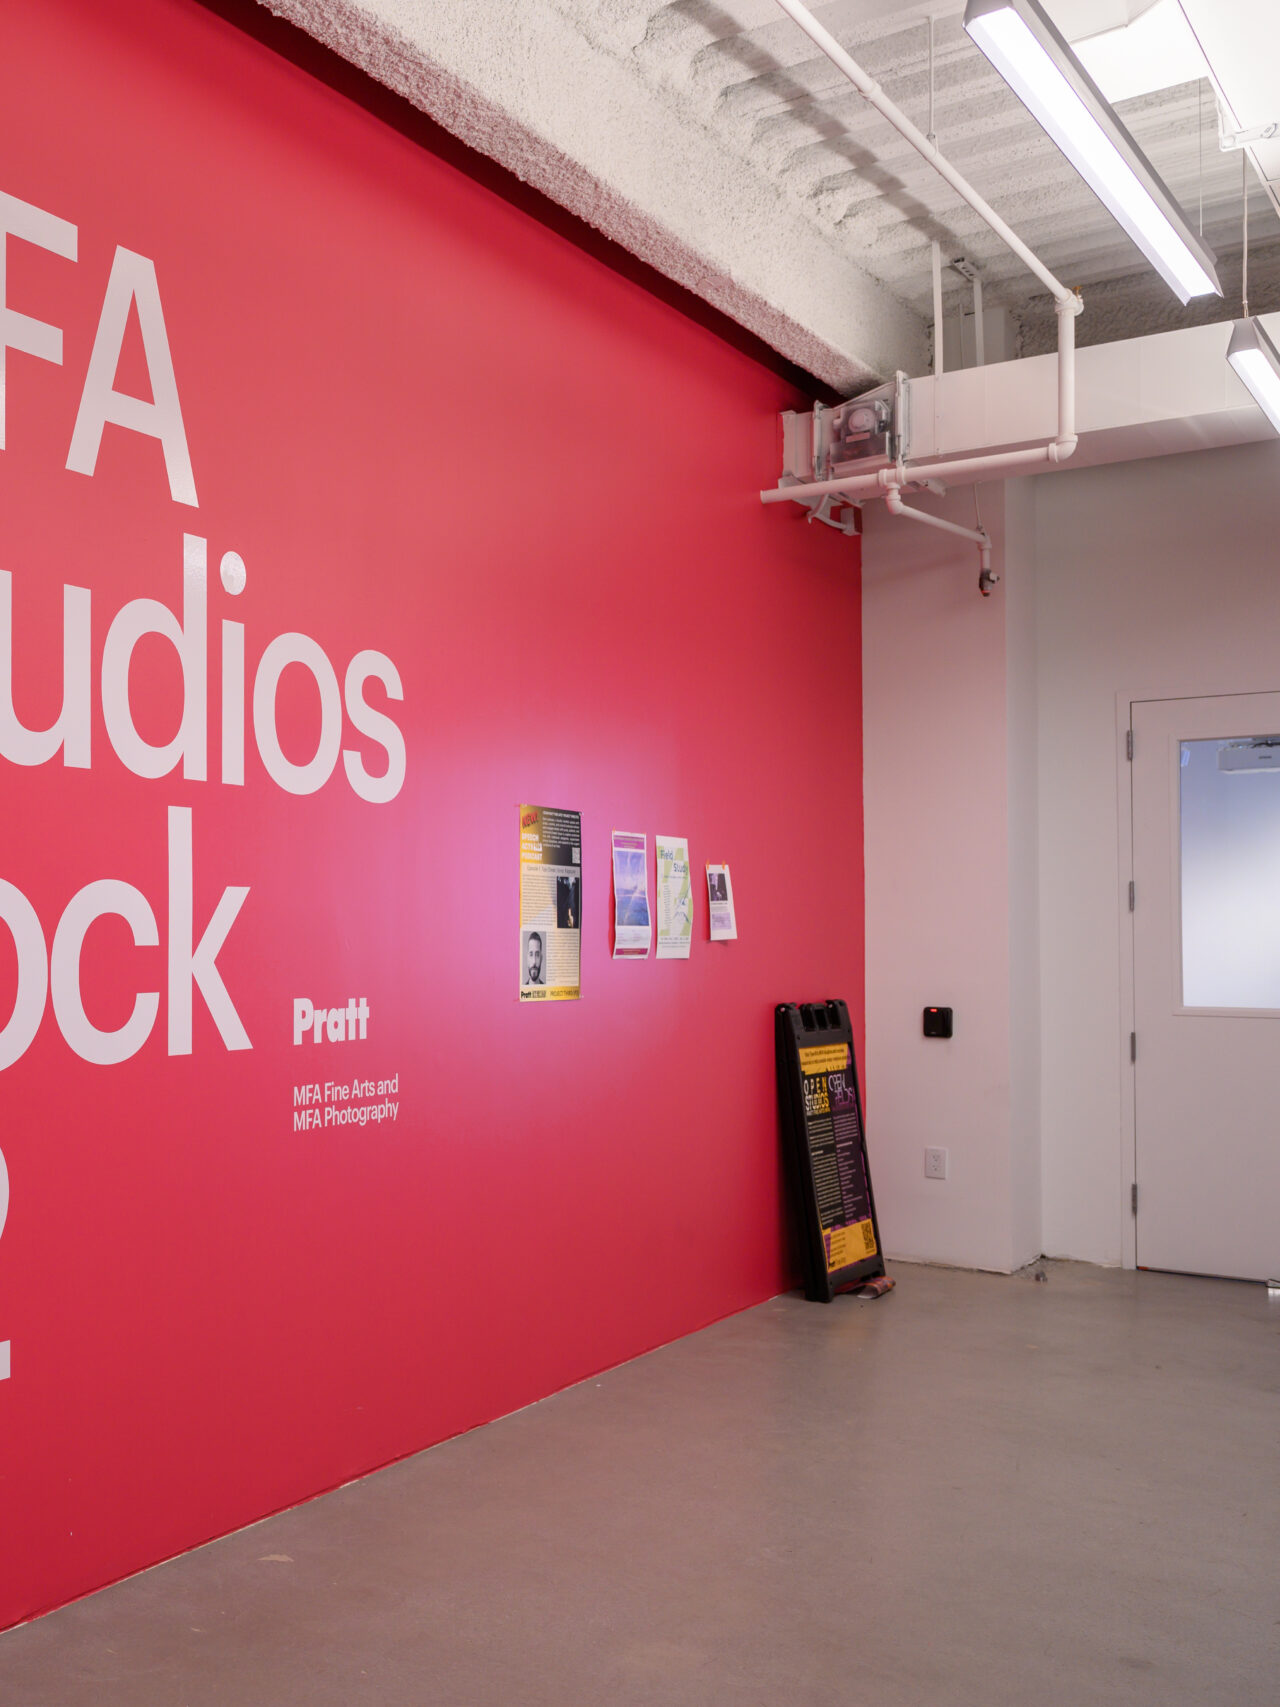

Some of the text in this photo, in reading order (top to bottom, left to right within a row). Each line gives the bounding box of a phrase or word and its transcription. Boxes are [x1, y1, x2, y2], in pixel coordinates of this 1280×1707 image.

[293, 998, 370, 1046] Pratt
[293, 1073, 399, 1107] MFA Fine Arts and
[293, 1097, 400, 1132] MFA Photography
